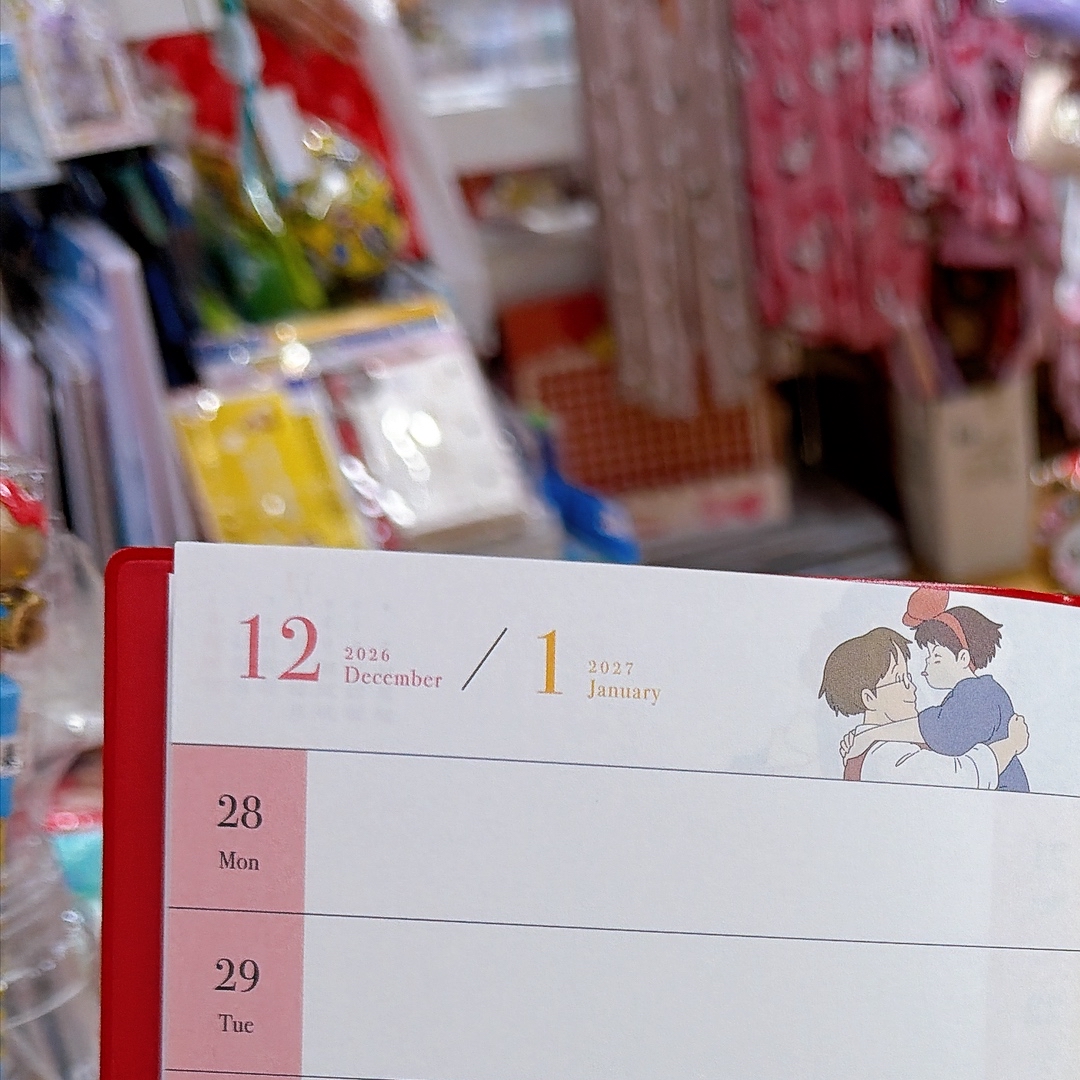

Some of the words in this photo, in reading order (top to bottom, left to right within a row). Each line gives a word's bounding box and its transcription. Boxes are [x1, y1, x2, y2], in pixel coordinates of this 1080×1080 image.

[240, 615, 320, 681] 12
[345, 647, 389, 662] 2026
[538, 630, 563, 694] 1
[589, 660, 633, 675] 2027
[346, 666, 442, 688] December
[587, 680, 660, 706] January
[217, 794, 262, 829] 28
[219, 851, 259, 870] Mon
[215, 958, 259, 992] 29
[219, 1013, 253, 1033] Tue
